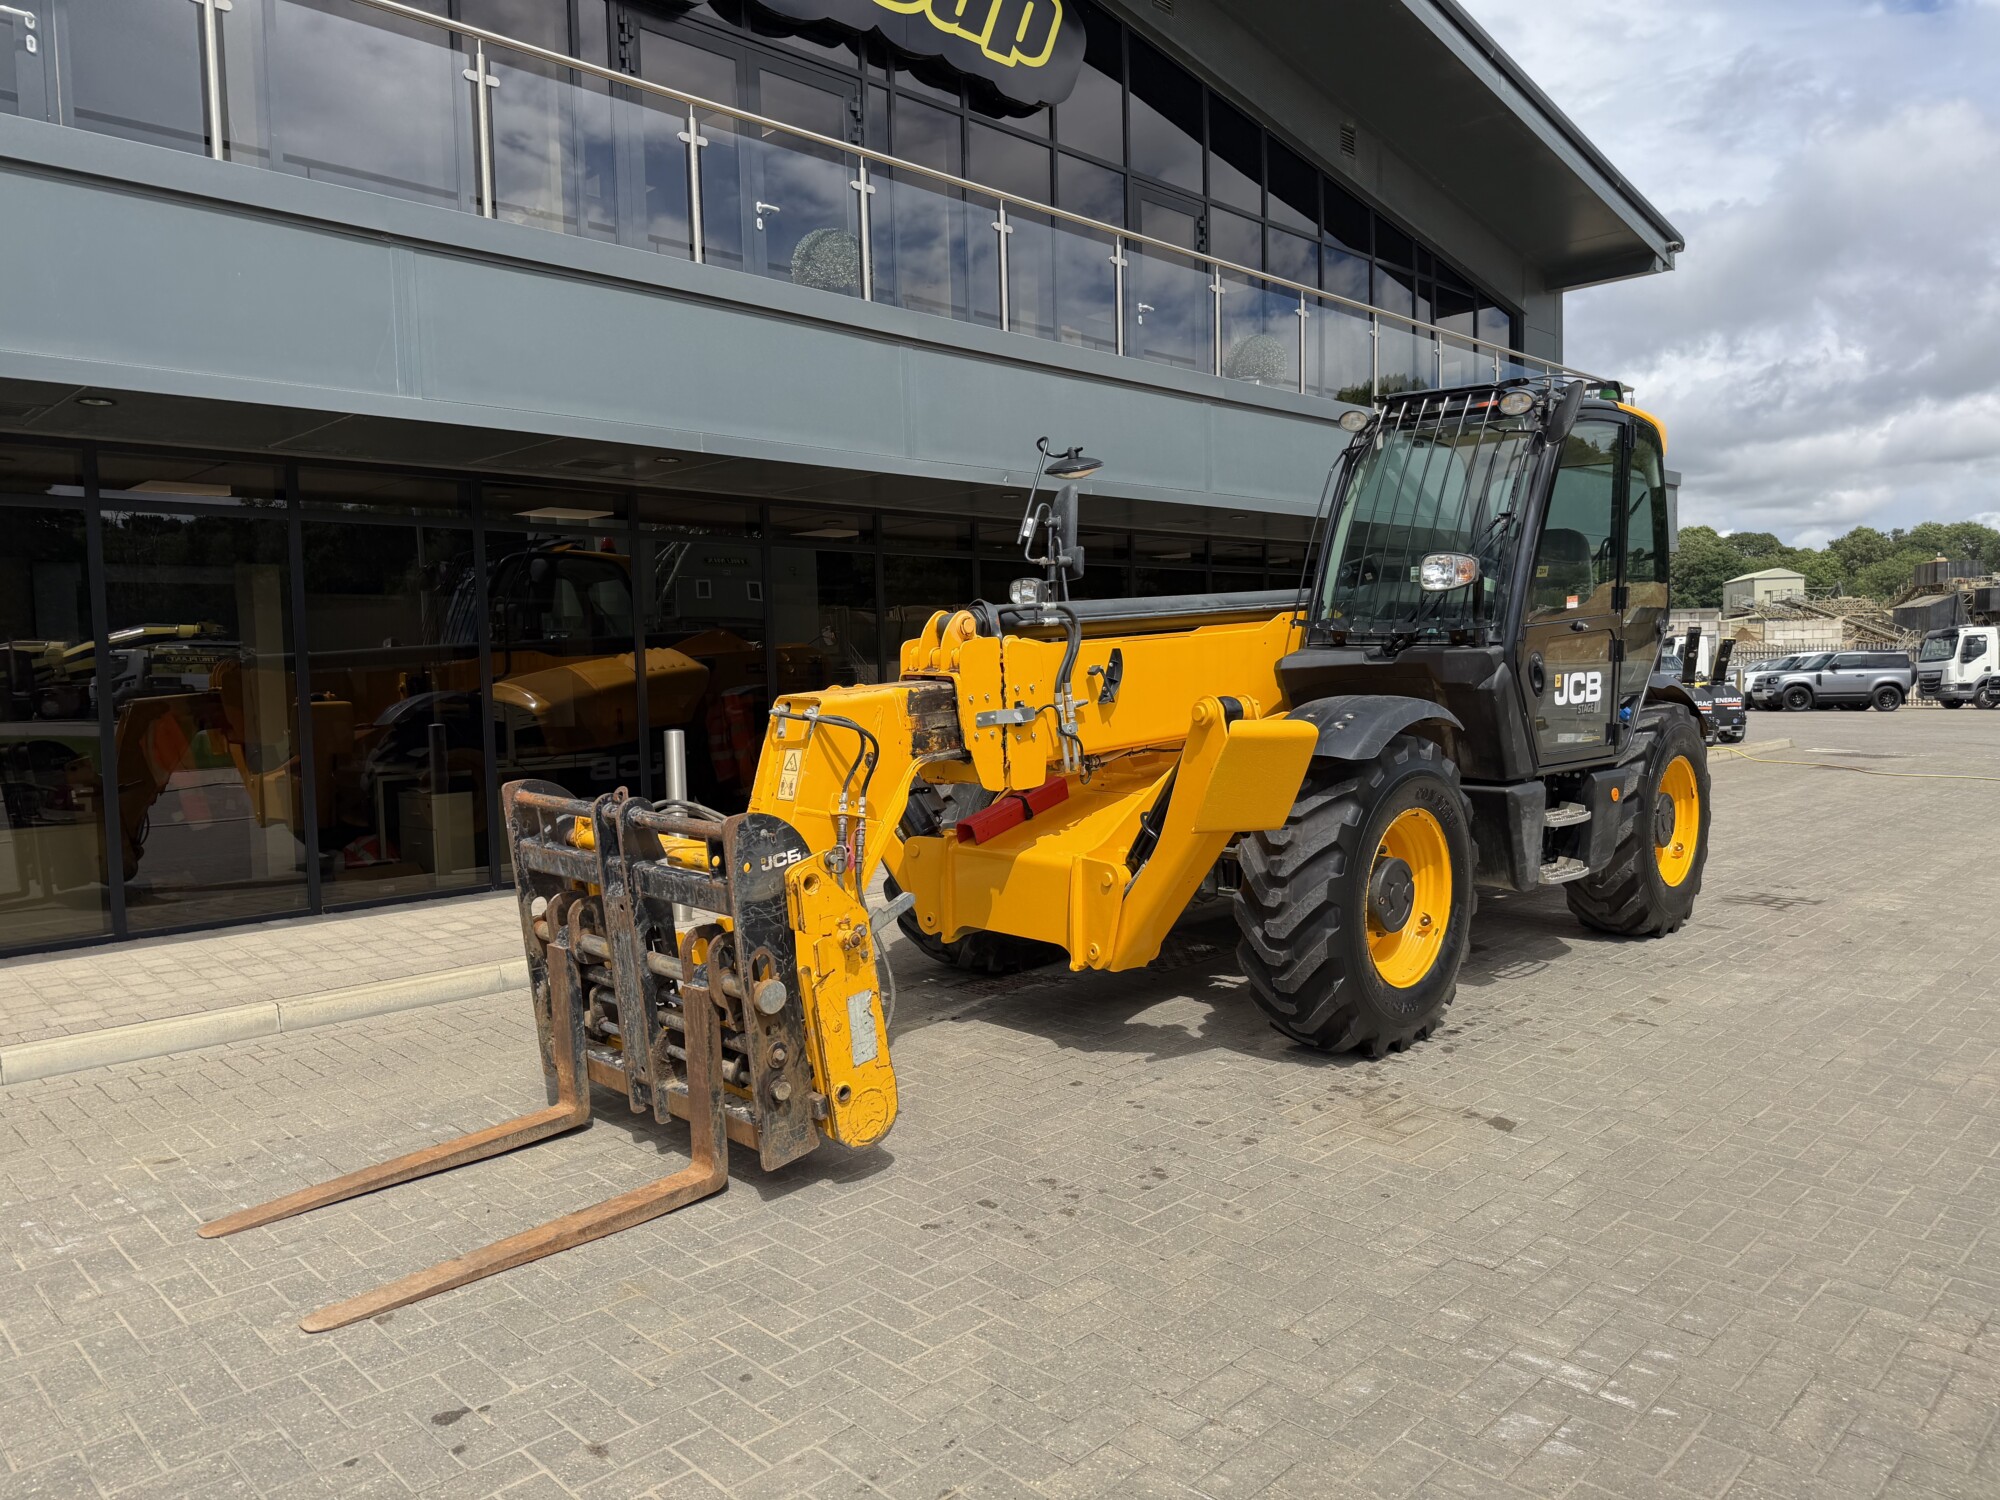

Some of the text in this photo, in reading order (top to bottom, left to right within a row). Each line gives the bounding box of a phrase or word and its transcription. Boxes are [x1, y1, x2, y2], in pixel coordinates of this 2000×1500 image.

[1554, 671, 1602, 706] JCB
[1577, 703, 1594, 714] STAGE
[761, 848, 802, 872] JCB
